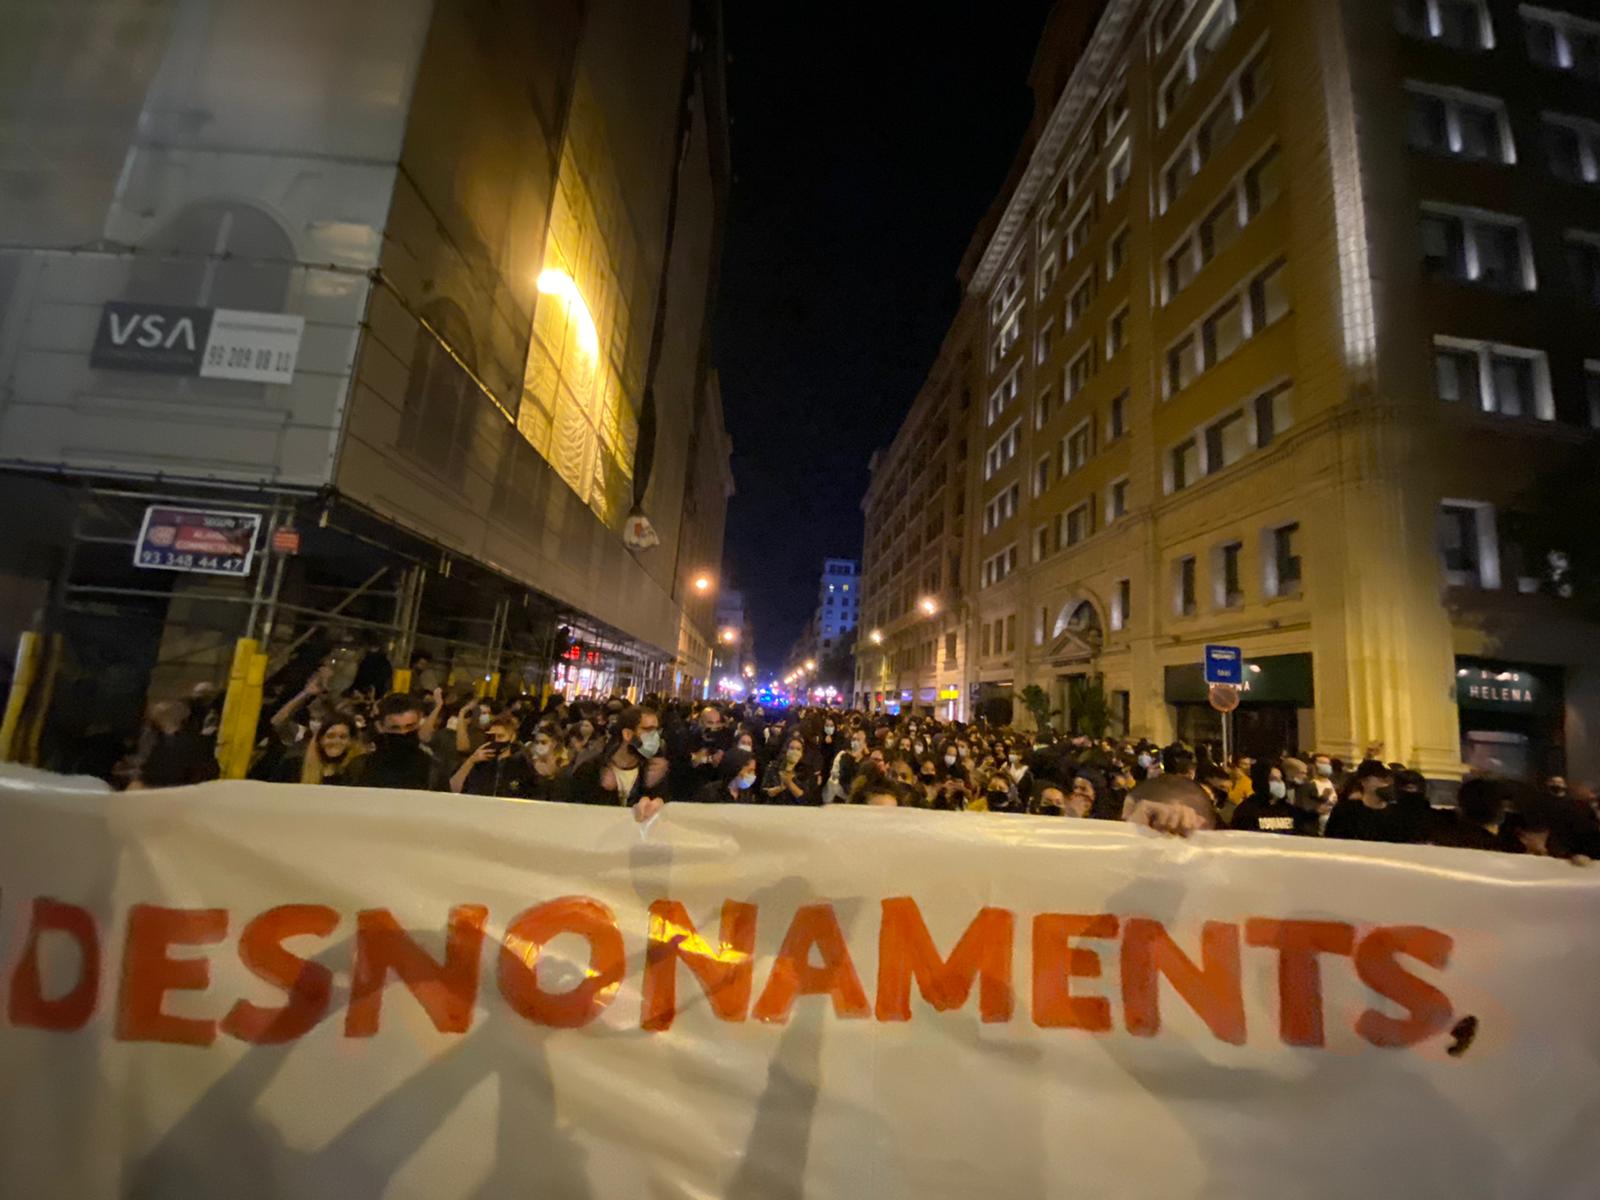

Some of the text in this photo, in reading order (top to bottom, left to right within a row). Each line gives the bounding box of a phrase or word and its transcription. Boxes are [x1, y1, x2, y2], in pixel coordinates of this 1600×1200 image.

[143, 551, 161, 564] 93
[198, 556, 218, 569] 44
[222, 558, 243, 571] 47
[1469, 685, 1533, 702] HELENA
